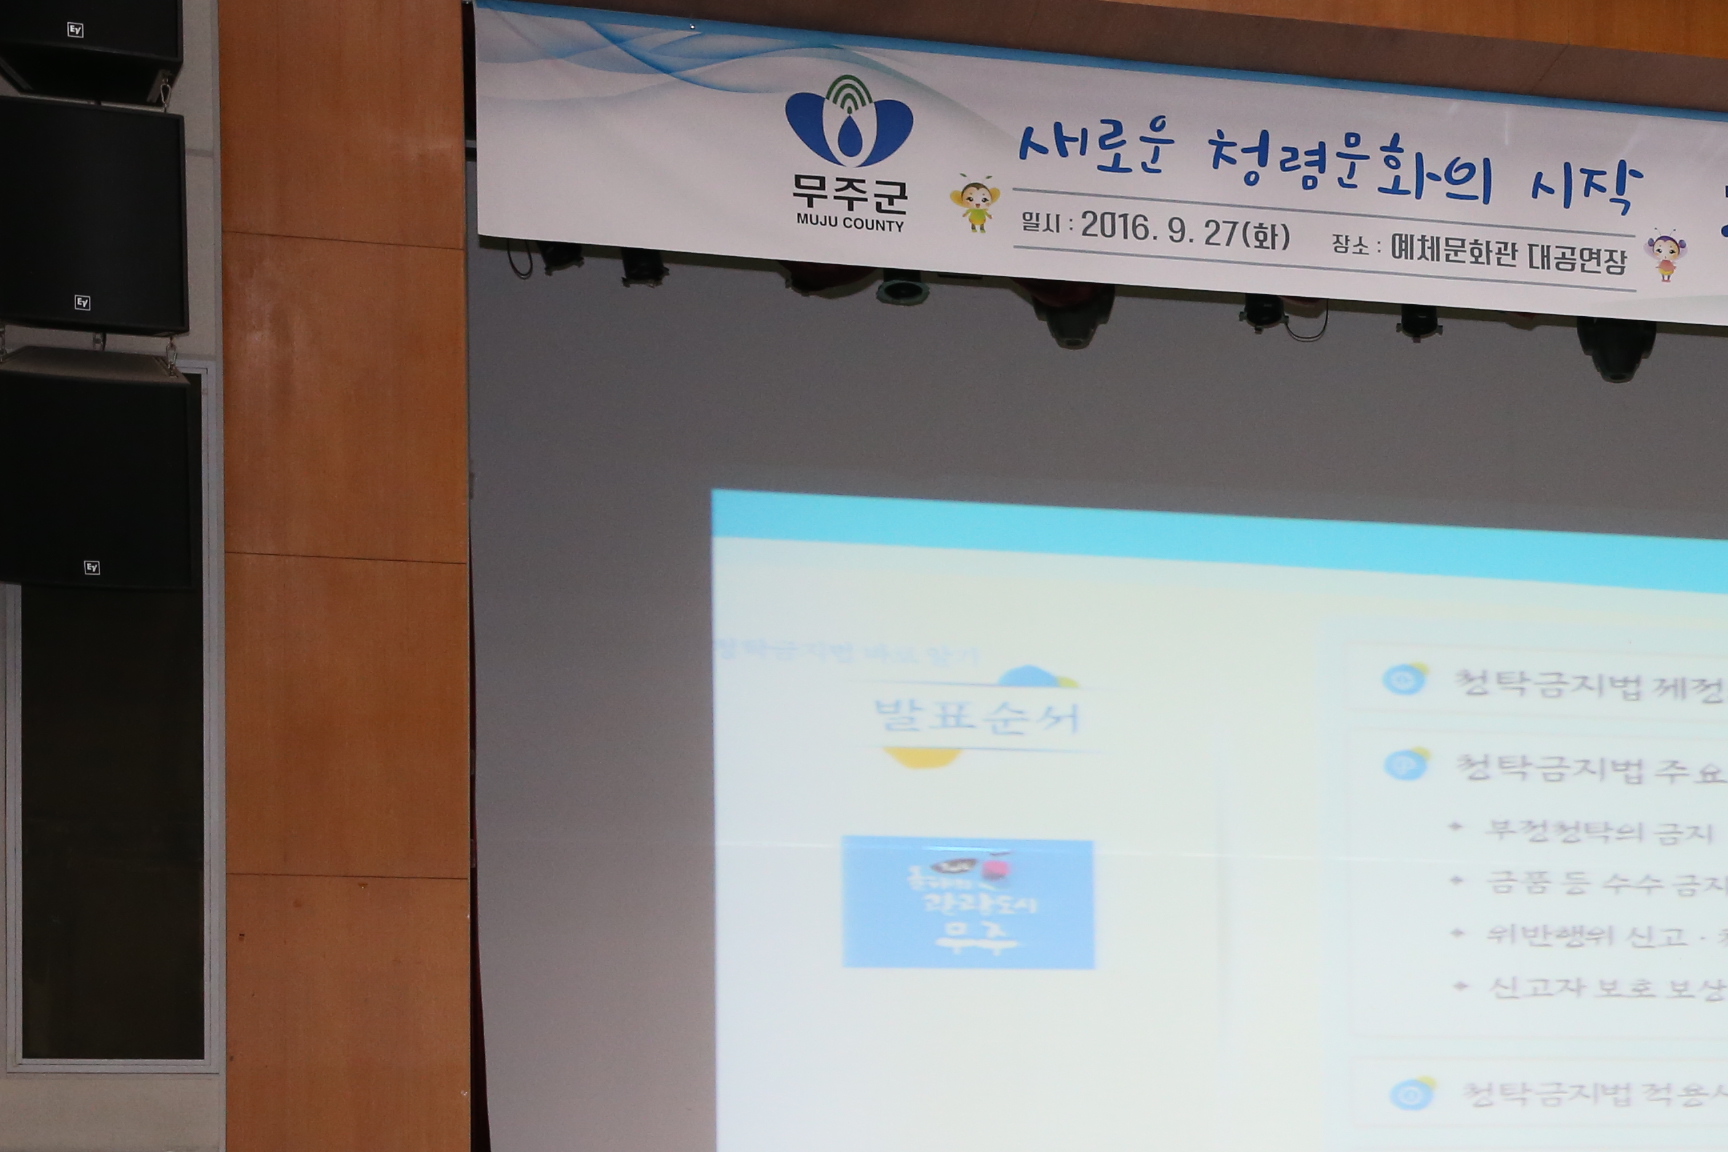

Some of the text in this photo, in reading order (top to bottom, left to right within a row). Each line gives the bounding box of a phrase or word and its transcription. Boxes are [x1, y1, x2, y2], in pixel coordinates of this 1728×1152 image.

[1019, 115, 1644, 216] 새로운 청렴문화의 시작
[793, 174, 908, 215] 무주군
[796, 213, 904, 233] MUJU COUNTY
[1022, 211, 1061, 234] 일시
[1081, 210, 1158, 241] 2016.
[1168, 216, 1194, 244] 9.
[1204, 218, 1291, 251] 27(화)
[1332, 233, 1370, 256] 장소
[1390, 232, 1519, 268] 예체문화관
[1527, 243, 1628, 275] 대공연장
[1455, 668, 1643, 702] 청탁금지법
[874, 698, 1080, 737] 발표순서
[1456, 753, 1644, 787] 청탁금지법
[1653, 822, 1714, 847] 금지
[1485, 869, 1551, 896] 금품
[1562, 872, 1591, 897] 등
[1600, 873, 1665, 897] 수수
[935, 920, 1020, 957] 무주
[1627, 924, 1689, 949] 신고
[1488, 975, 1728, 1004] 신고자 보호 보상
[1463, 1081, 1633, 1109] 청탁금지법
